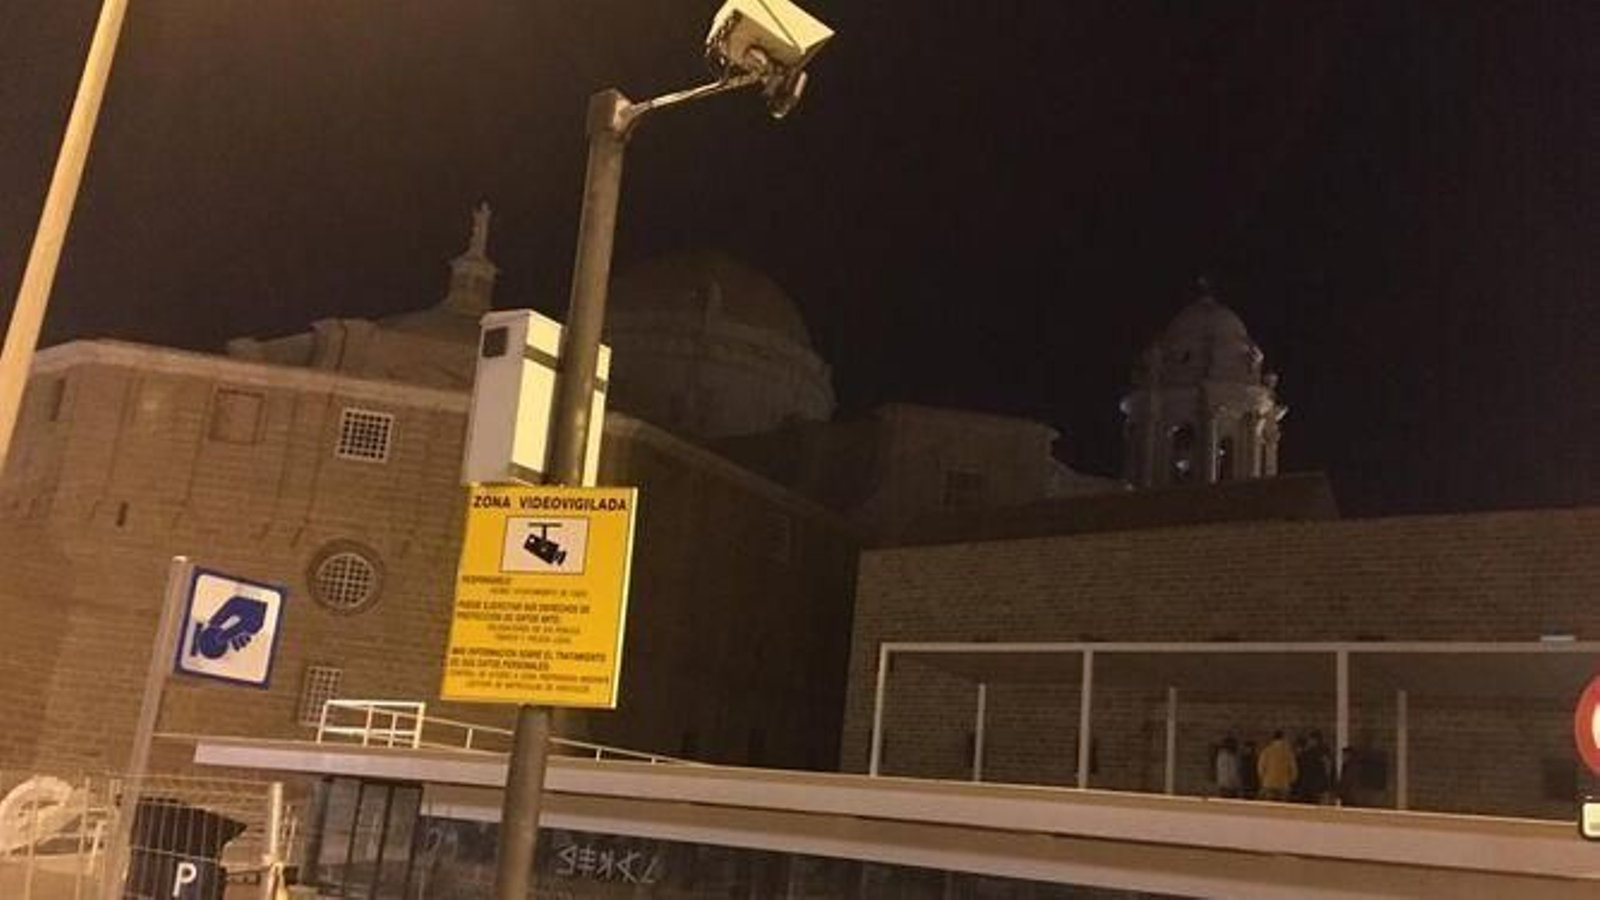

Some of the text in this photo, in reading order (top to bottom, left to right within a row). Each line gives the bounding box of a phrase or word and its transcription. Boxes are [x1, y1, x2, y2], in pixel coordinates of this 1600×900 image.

[473, 495, 627, 511] ZONA VIDEOVIGILADA
[172, 862, 197, 898] P
